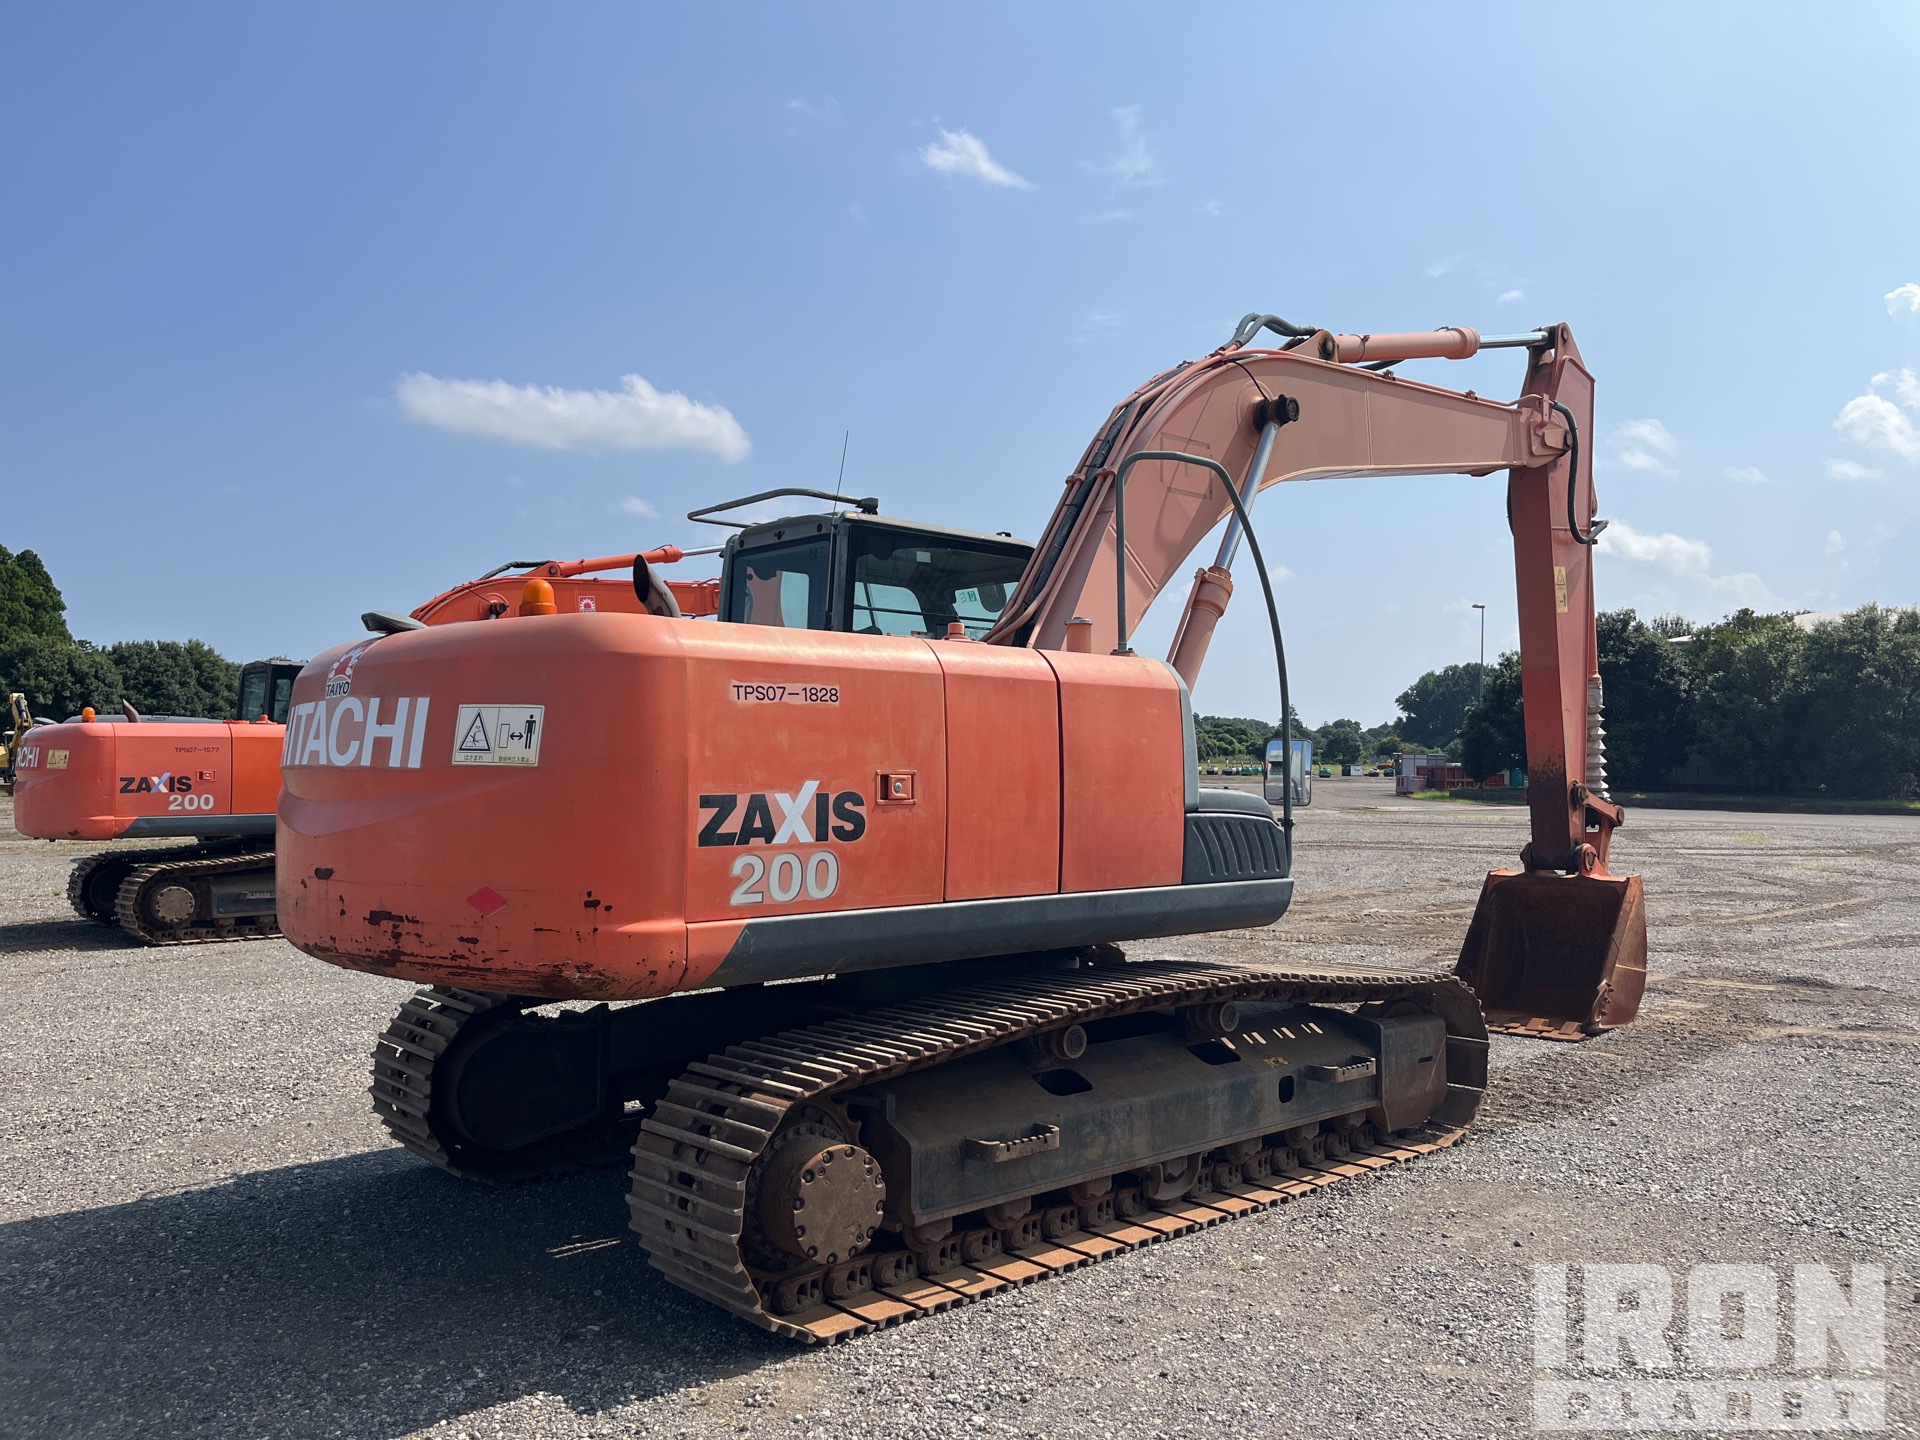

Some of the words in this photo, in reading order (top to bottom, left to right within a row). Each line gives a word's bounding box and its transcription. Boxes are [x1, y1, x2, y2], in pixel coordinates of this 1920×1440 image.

[326, 681, 351, 697] TAIYO
[732, 684, 840, 703] TPS07-1828
[119, 772, 192, 793] ZAXIS
[168, 794, 214, 810] 200
[698, 780, 866, 848] ZAXIS
[729, 850, 840, 906] 200
